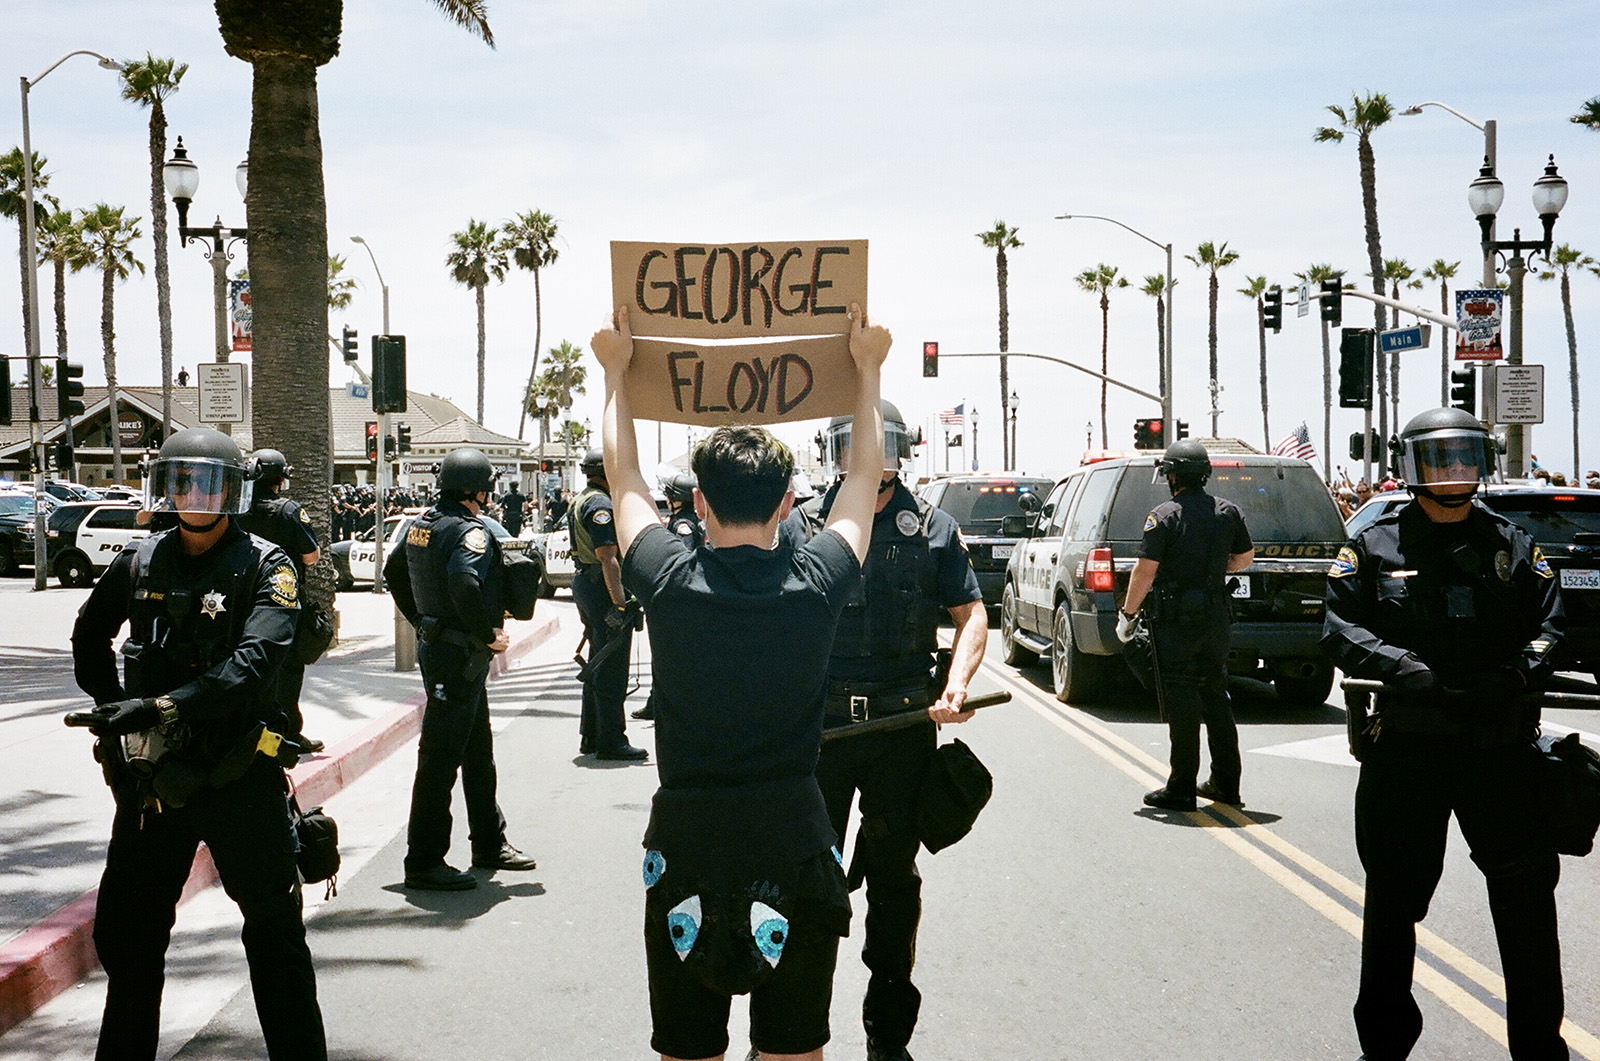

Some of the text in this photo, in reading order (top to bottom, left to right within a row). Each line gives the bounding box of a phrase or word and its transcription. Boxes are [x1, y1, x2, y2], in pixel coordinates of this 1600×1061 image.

[635, 245, 850, 328] GEORGE
[1389, 334, 1412, 347] Main
[666, 350, 814, 416] FLOYD
[412, 464, 432, 472] VISITO
[1022, 567, 1052, 590] POLICE
[1563, 576, 1599, 588] 1523456
